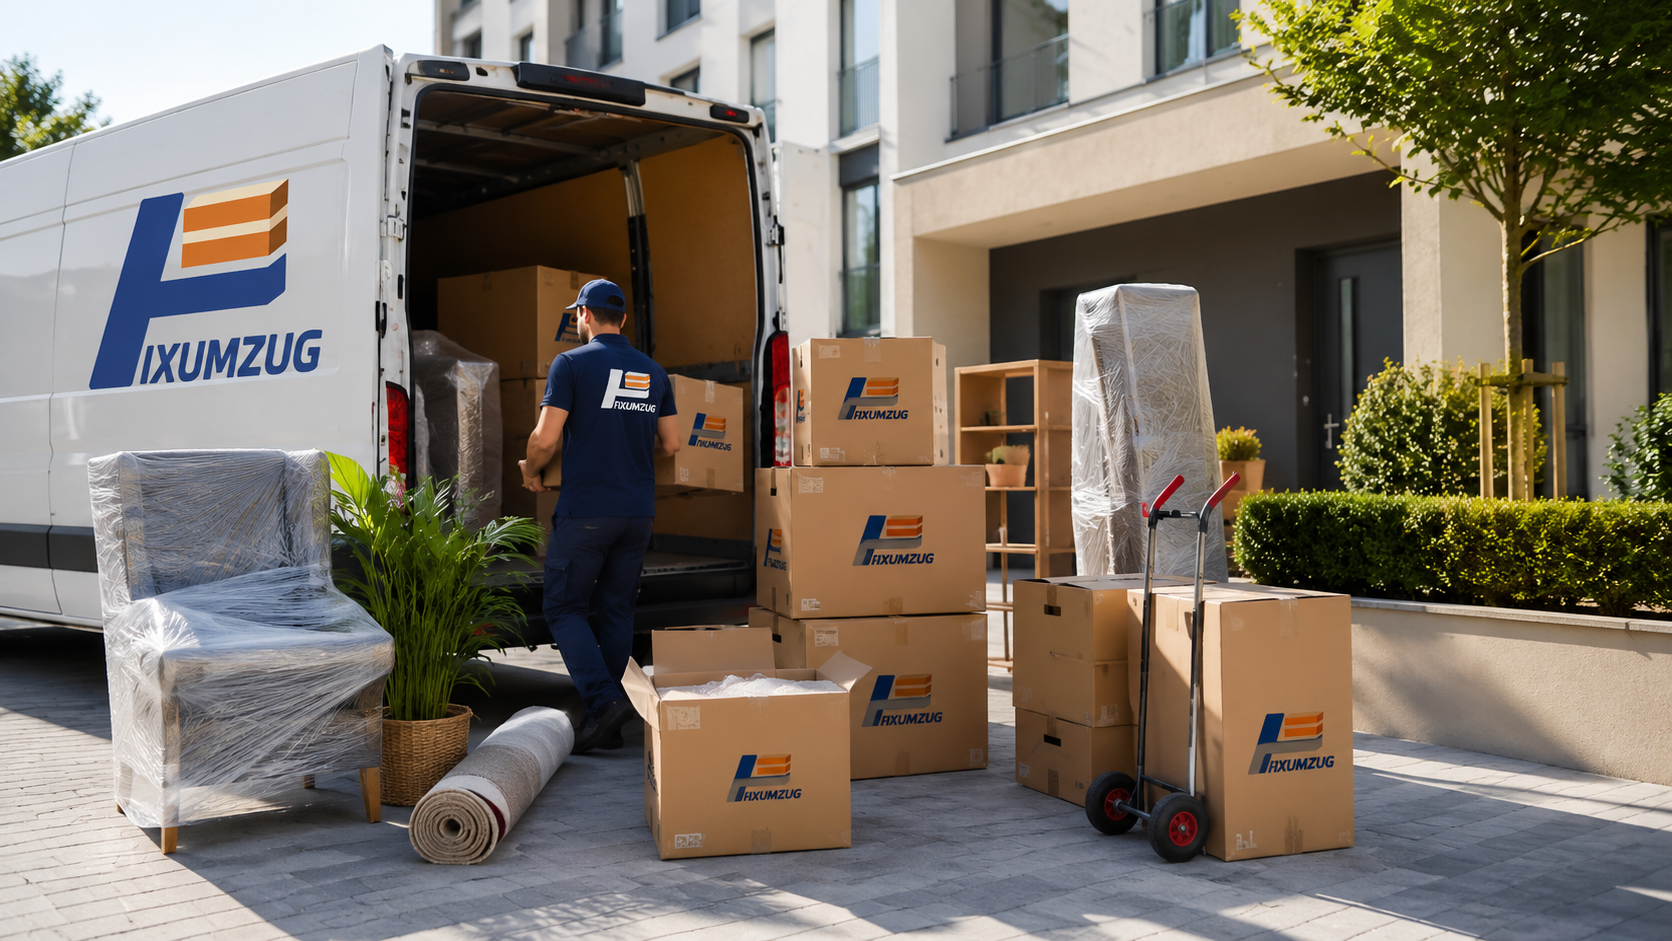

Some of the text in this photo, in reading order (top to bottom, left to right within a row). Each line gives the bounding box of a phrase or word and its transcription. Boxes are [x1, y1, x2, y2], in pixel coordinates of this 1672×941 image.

[853, 409, 909, 420] FIXUMZUG
[870, 553, 935, 566] FIXUMZUG
[1267, 755, 1335, 774] FIXUMZUG
